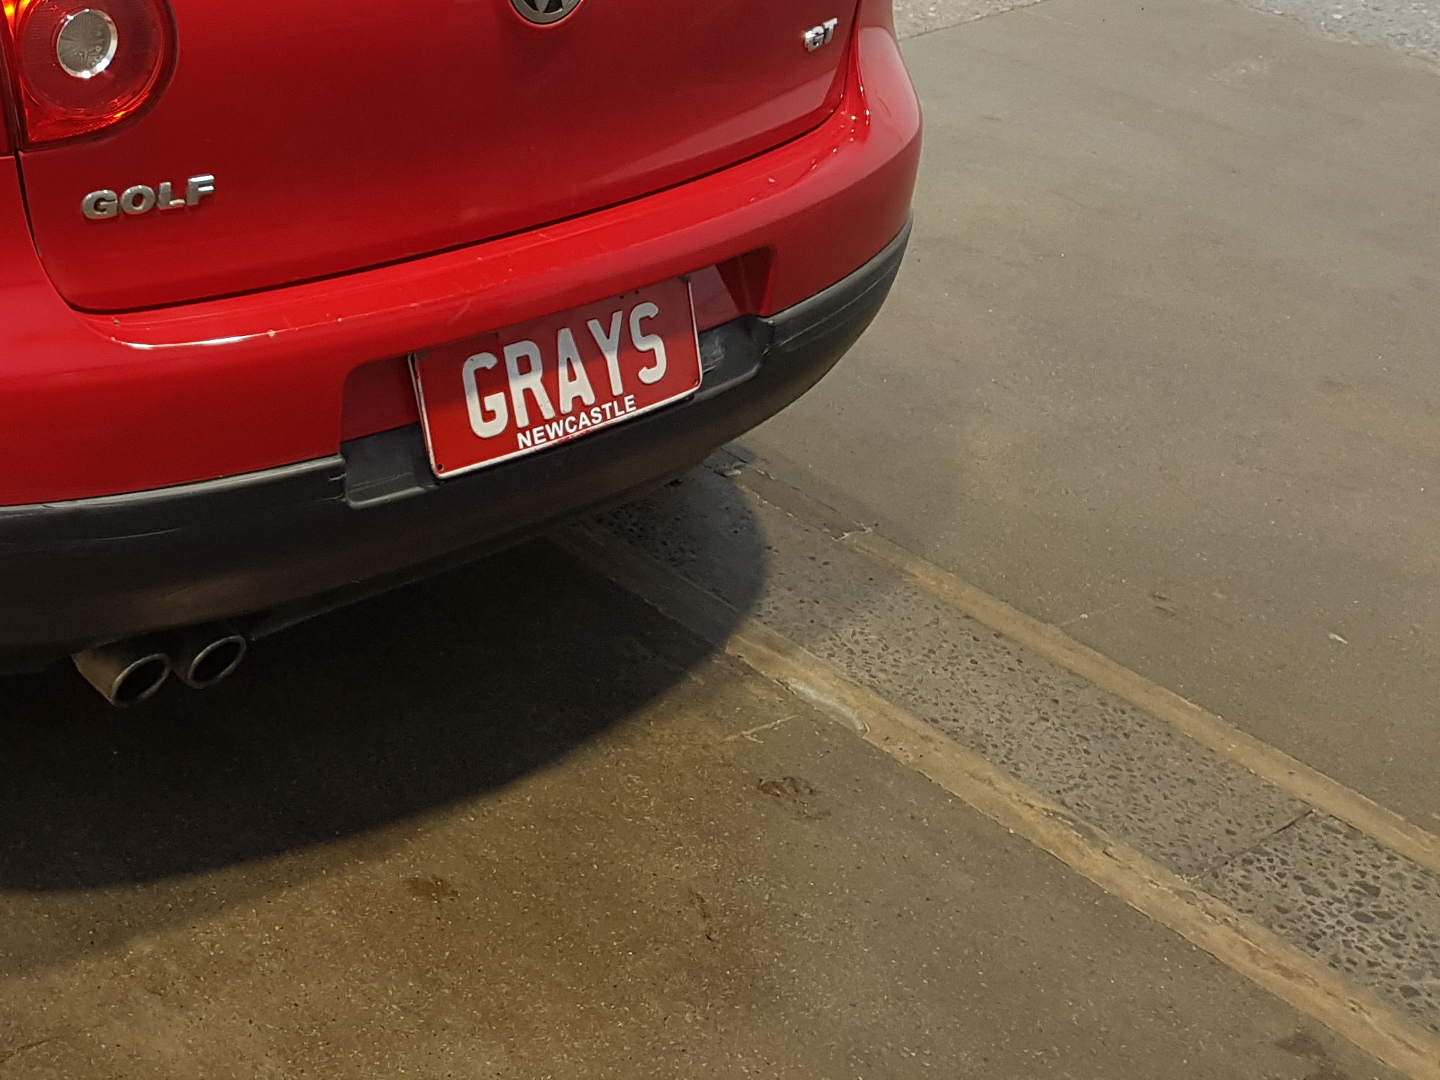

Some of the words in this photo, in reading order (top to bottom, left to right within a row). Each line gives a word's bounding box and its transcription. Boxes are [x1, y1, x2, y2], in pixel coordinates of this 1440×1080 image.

[81, 173, 216, 220] GOLF
[461, 301, 668, 439] GRAYS
[516, 394, 638, 450] NEWCASTLE
